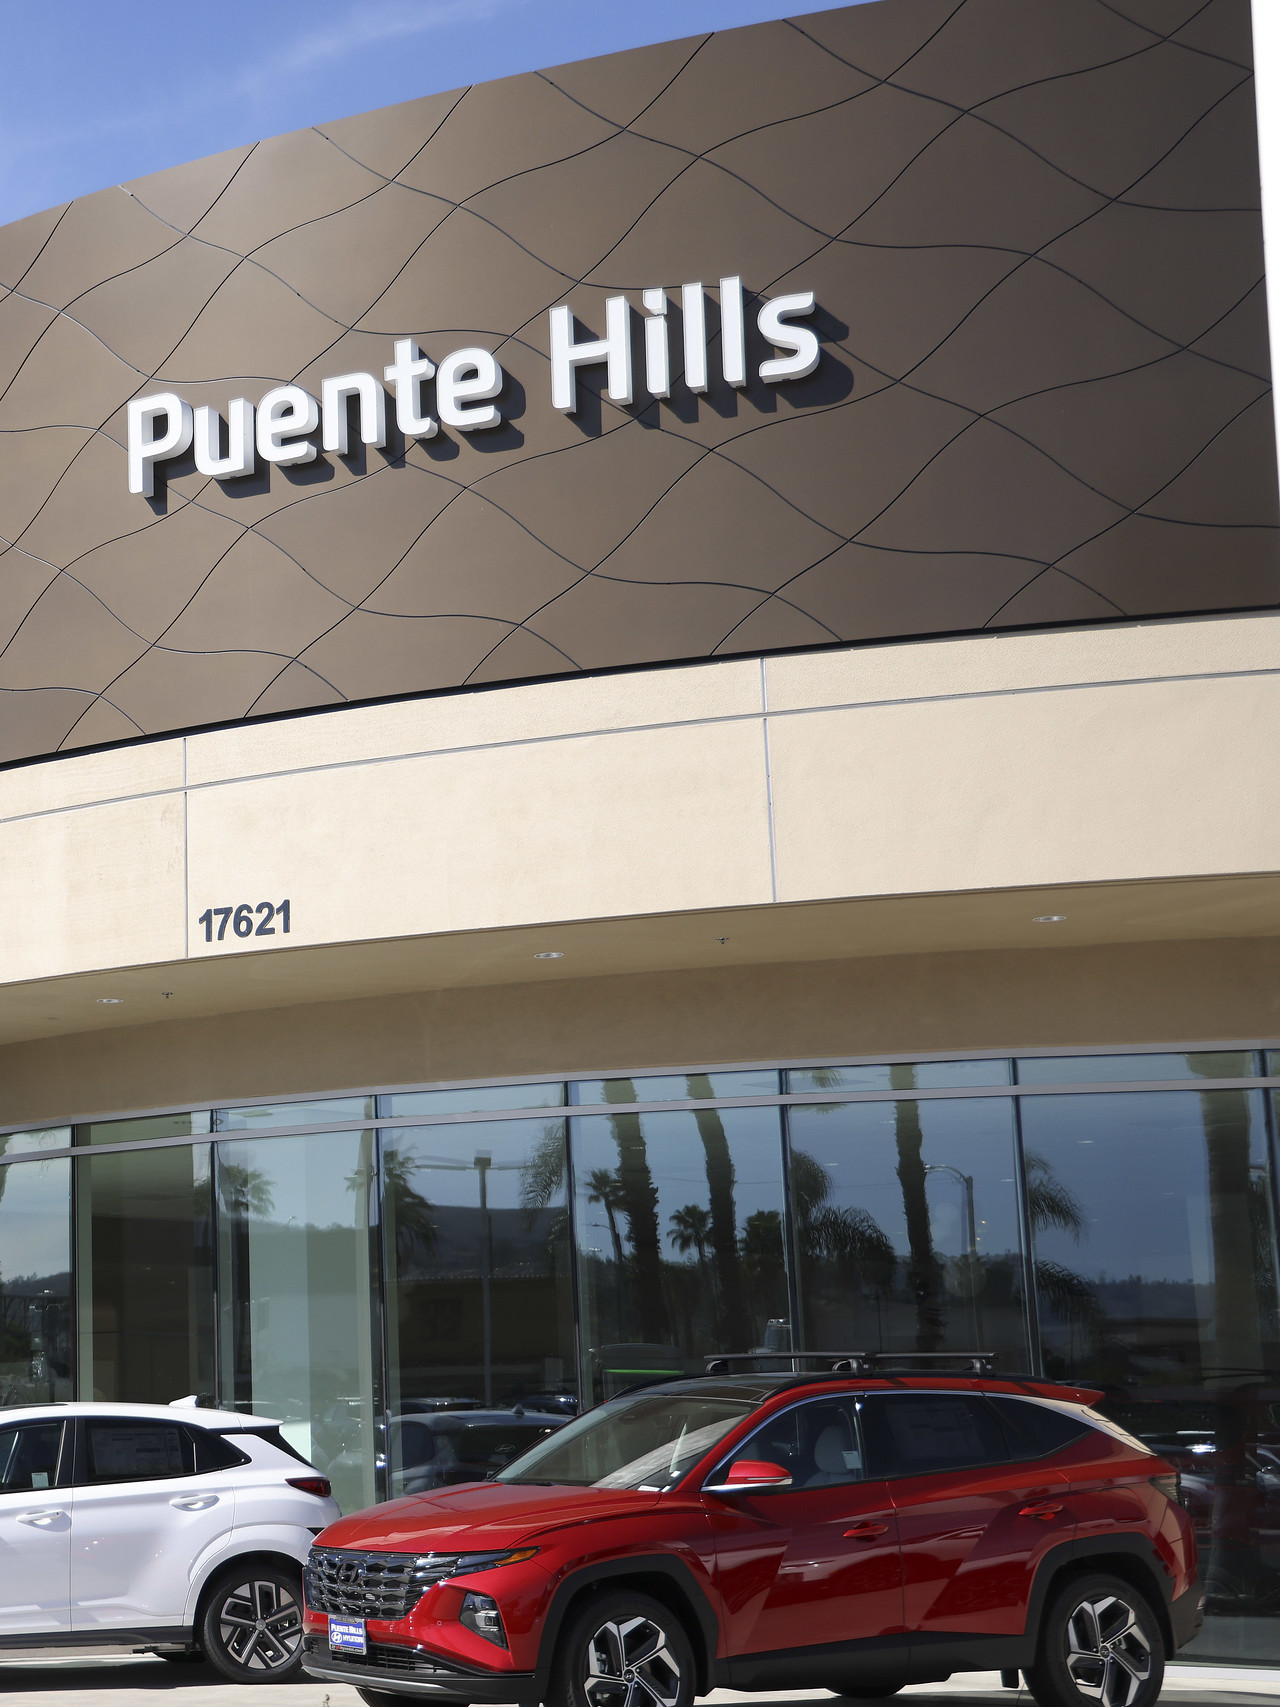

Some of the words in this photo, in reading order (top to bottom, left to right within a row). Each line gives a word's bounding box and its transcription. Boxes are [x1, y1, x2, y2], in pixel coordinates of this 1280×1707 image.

[127, 338, 503, 497] Puente
[549, 275, 822, 413] Hills
[198, 899, 291, 942] 17621
